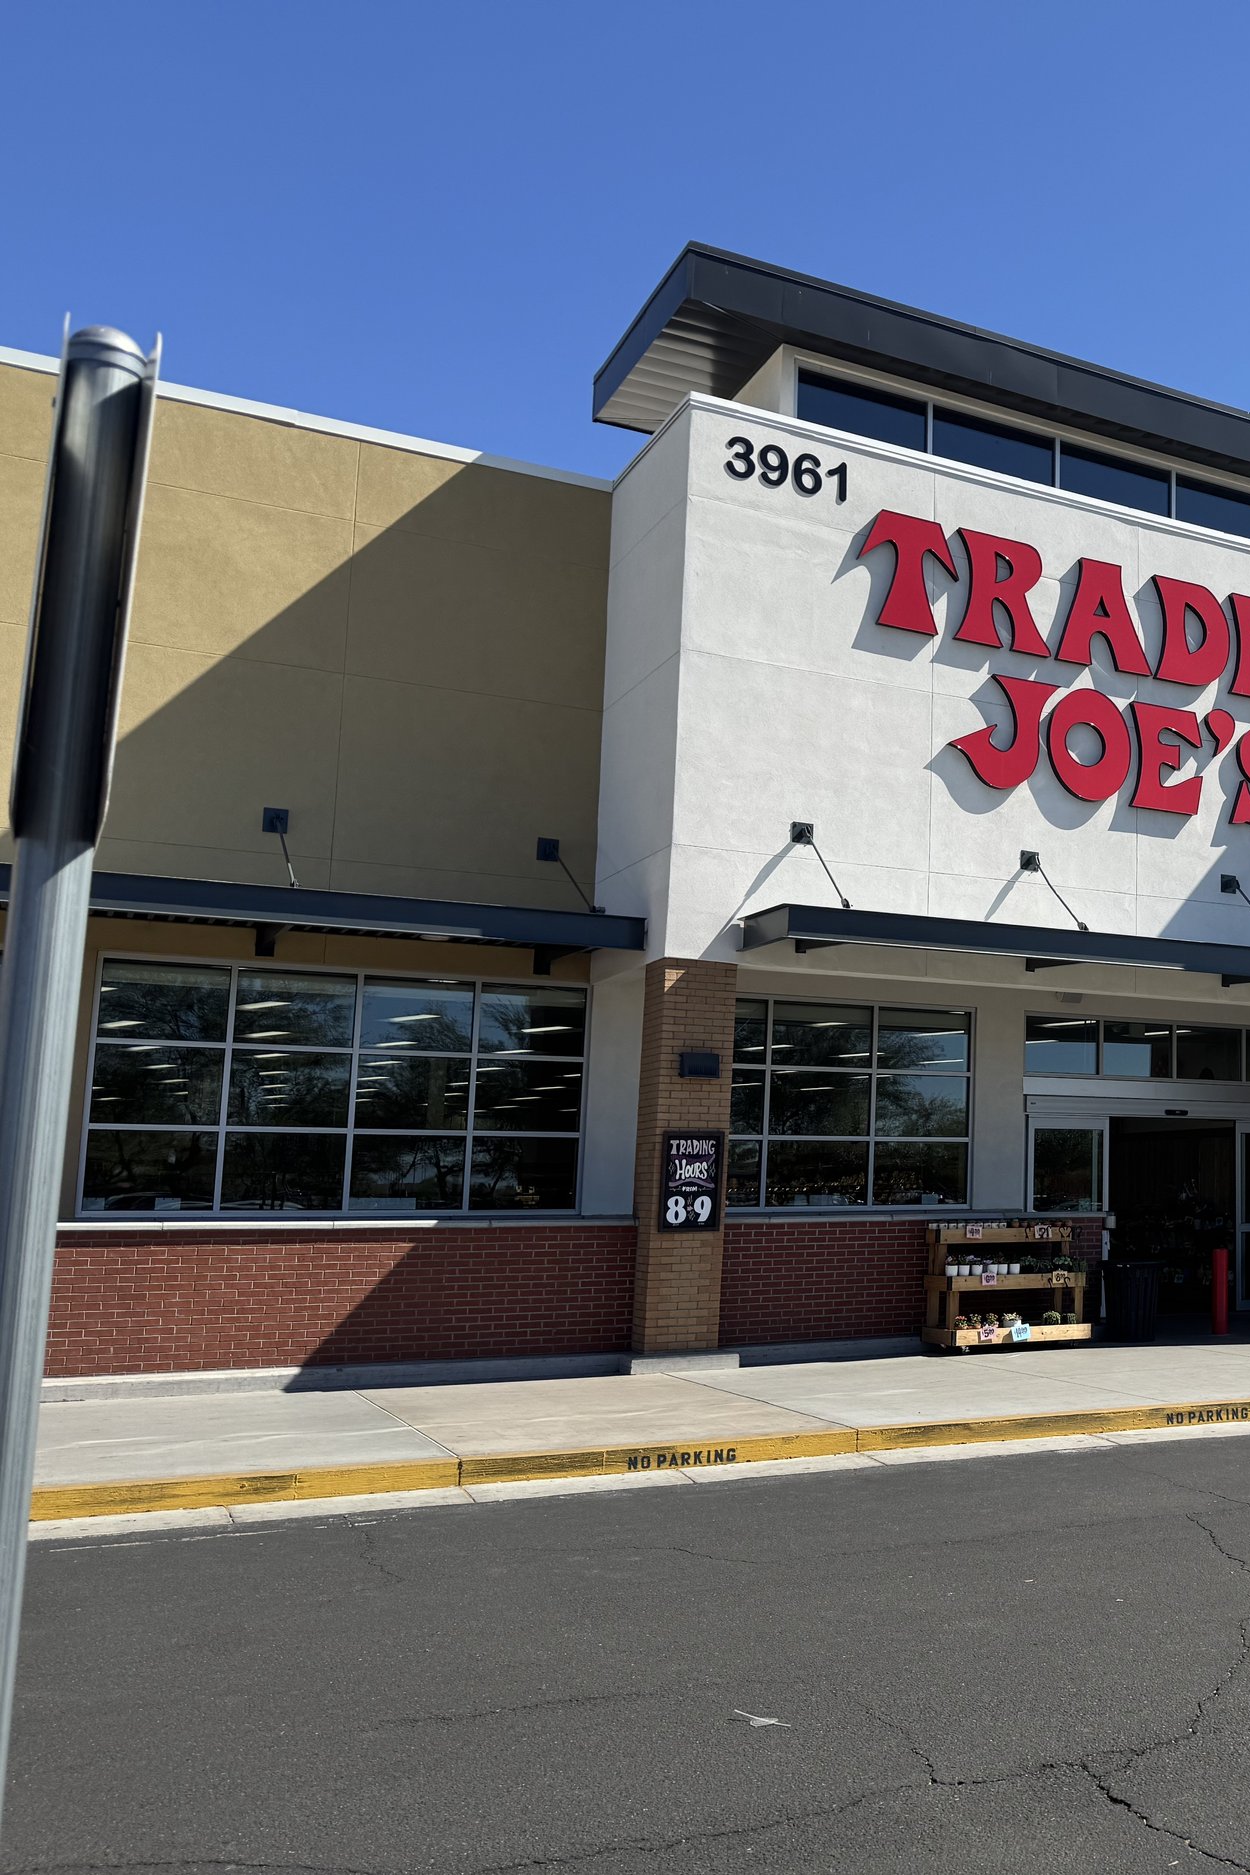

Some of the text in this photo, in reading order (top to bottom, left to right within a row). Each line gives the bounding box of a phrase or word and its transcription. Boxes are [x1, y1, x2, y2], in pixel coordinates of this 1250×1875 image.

[725, 436, 847, 502] 3961
[670, 1139, 716, 1155] TRADING
[666, 1195, 712, 1224] 8 9
[1166, 1407, 1249, 1425] NO PARKING
[627, 1447, 737, 1470] NO PARKING
